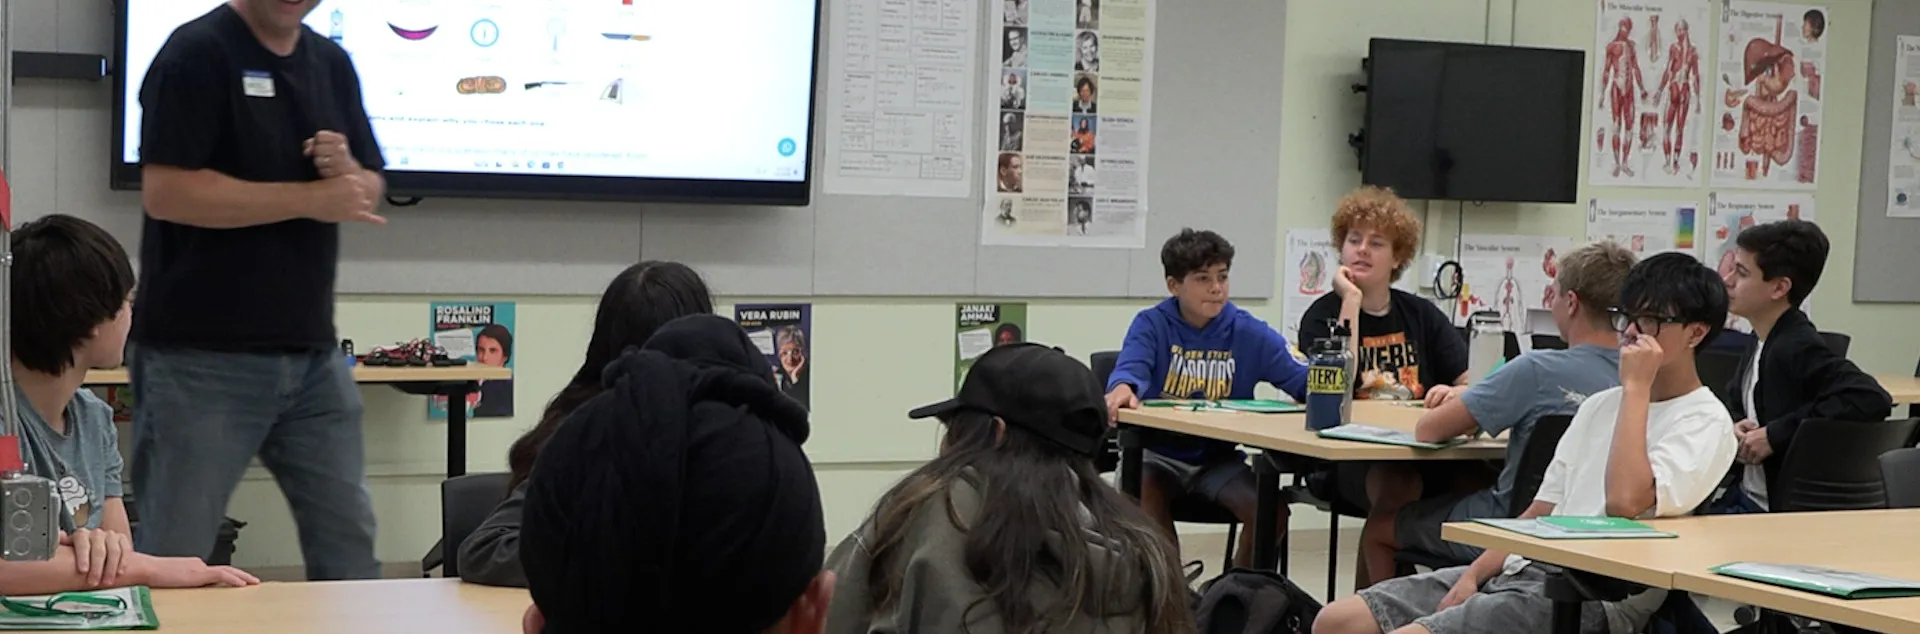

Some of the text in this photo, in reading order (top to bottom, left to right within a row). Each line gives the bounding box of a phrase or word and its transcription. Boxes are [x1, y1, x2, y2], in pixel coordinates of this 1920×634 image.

[436, 306, 492, 315] ROSALIND
[961, 304, 996, 313] JANAKI
[436, 315, 491, 324] FRANKLIN
[740, 310, 801, 320] VERA RUBIN
[960, 313, 996, 321] AMMAL
[1163, 354, 1236, 401] WARRIORS
